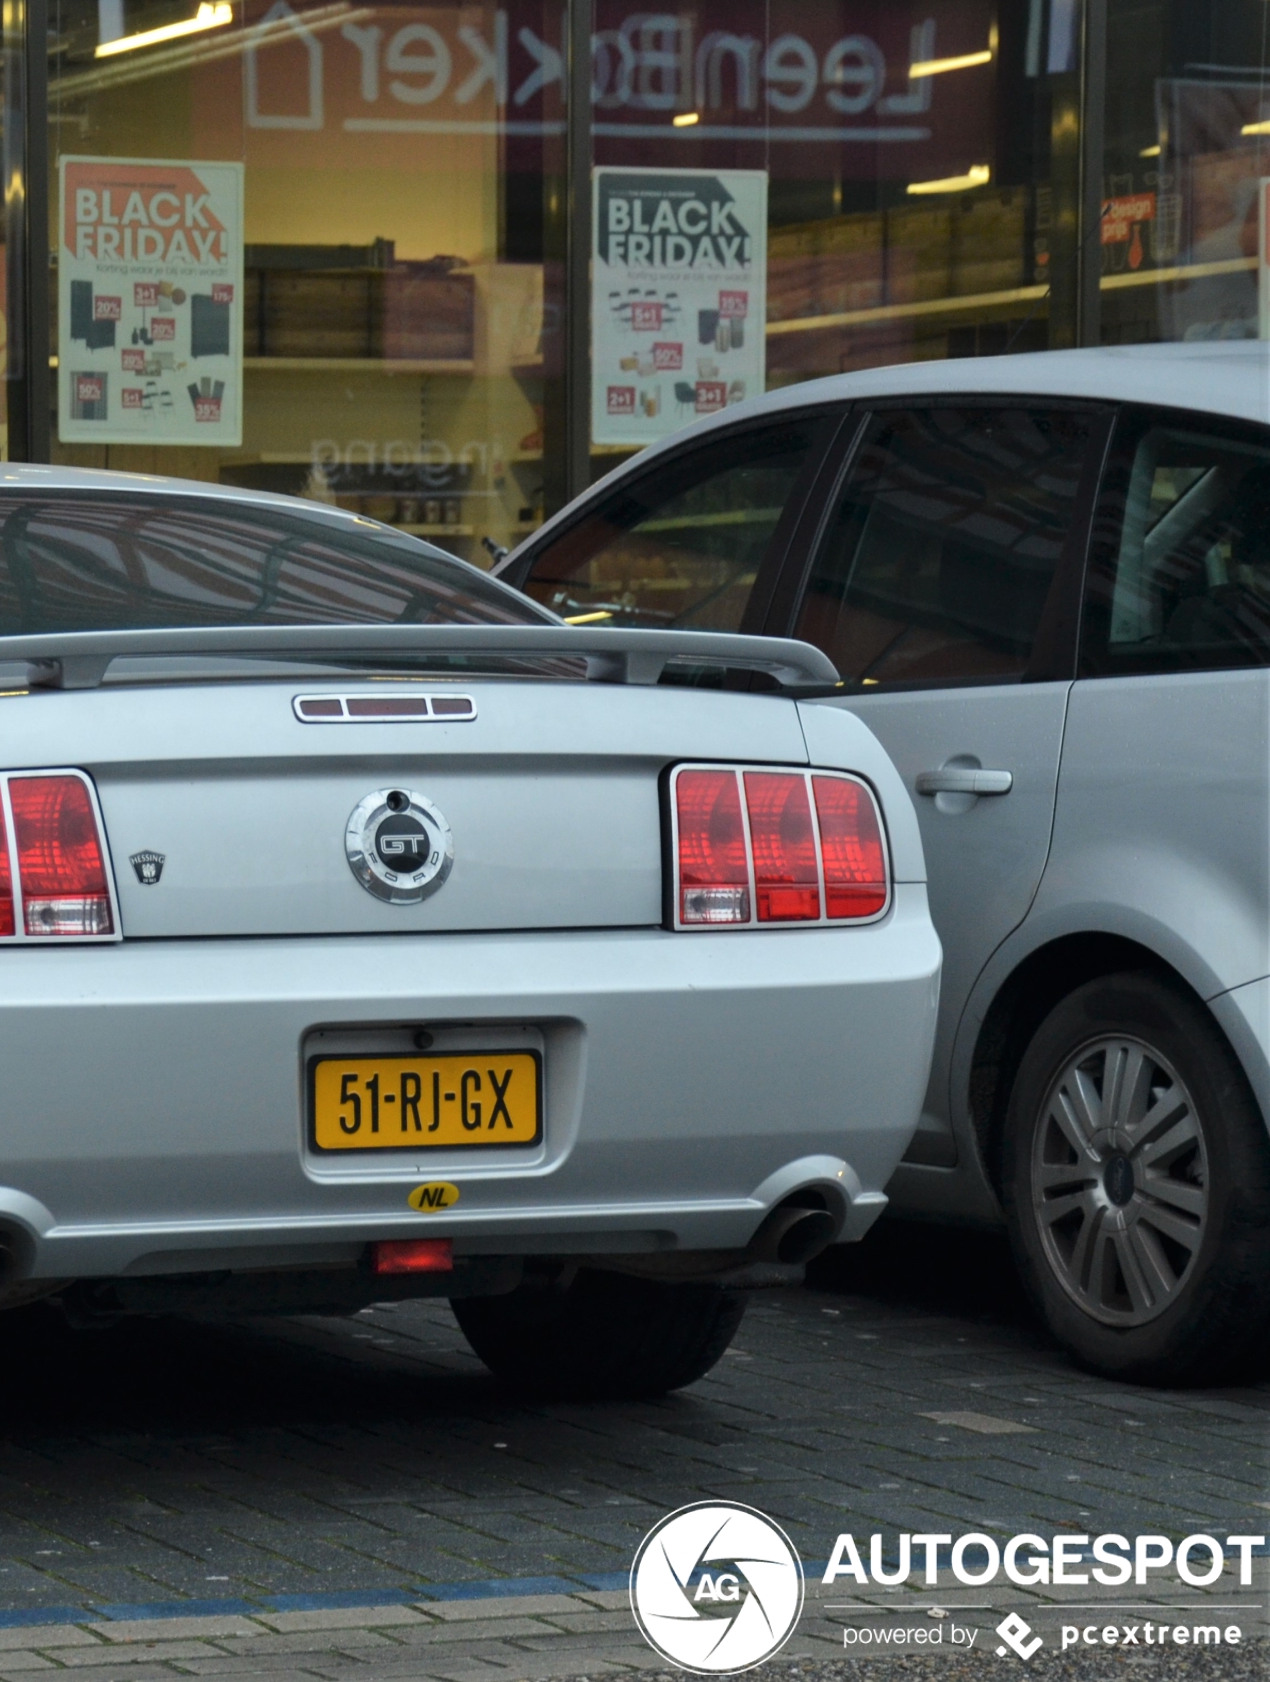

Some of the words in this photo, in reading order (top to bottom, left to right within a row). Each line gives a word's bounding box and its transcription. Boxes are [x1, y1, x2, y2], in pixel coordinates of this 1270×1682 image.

[76, 188, 210, 229] BLACK
[609, 198, 736, 236] BLACK
[76, 225, 229, 267] FRIDAY!
[608, 234, 752, 270] FRIDAY!
[135, 287, 156, 299] 3+1
[380, 834, 425, 854] GT
[339, 1068, 514, 1135] 51-RJ-GX
[418, 1187, 449, 1208] NL
